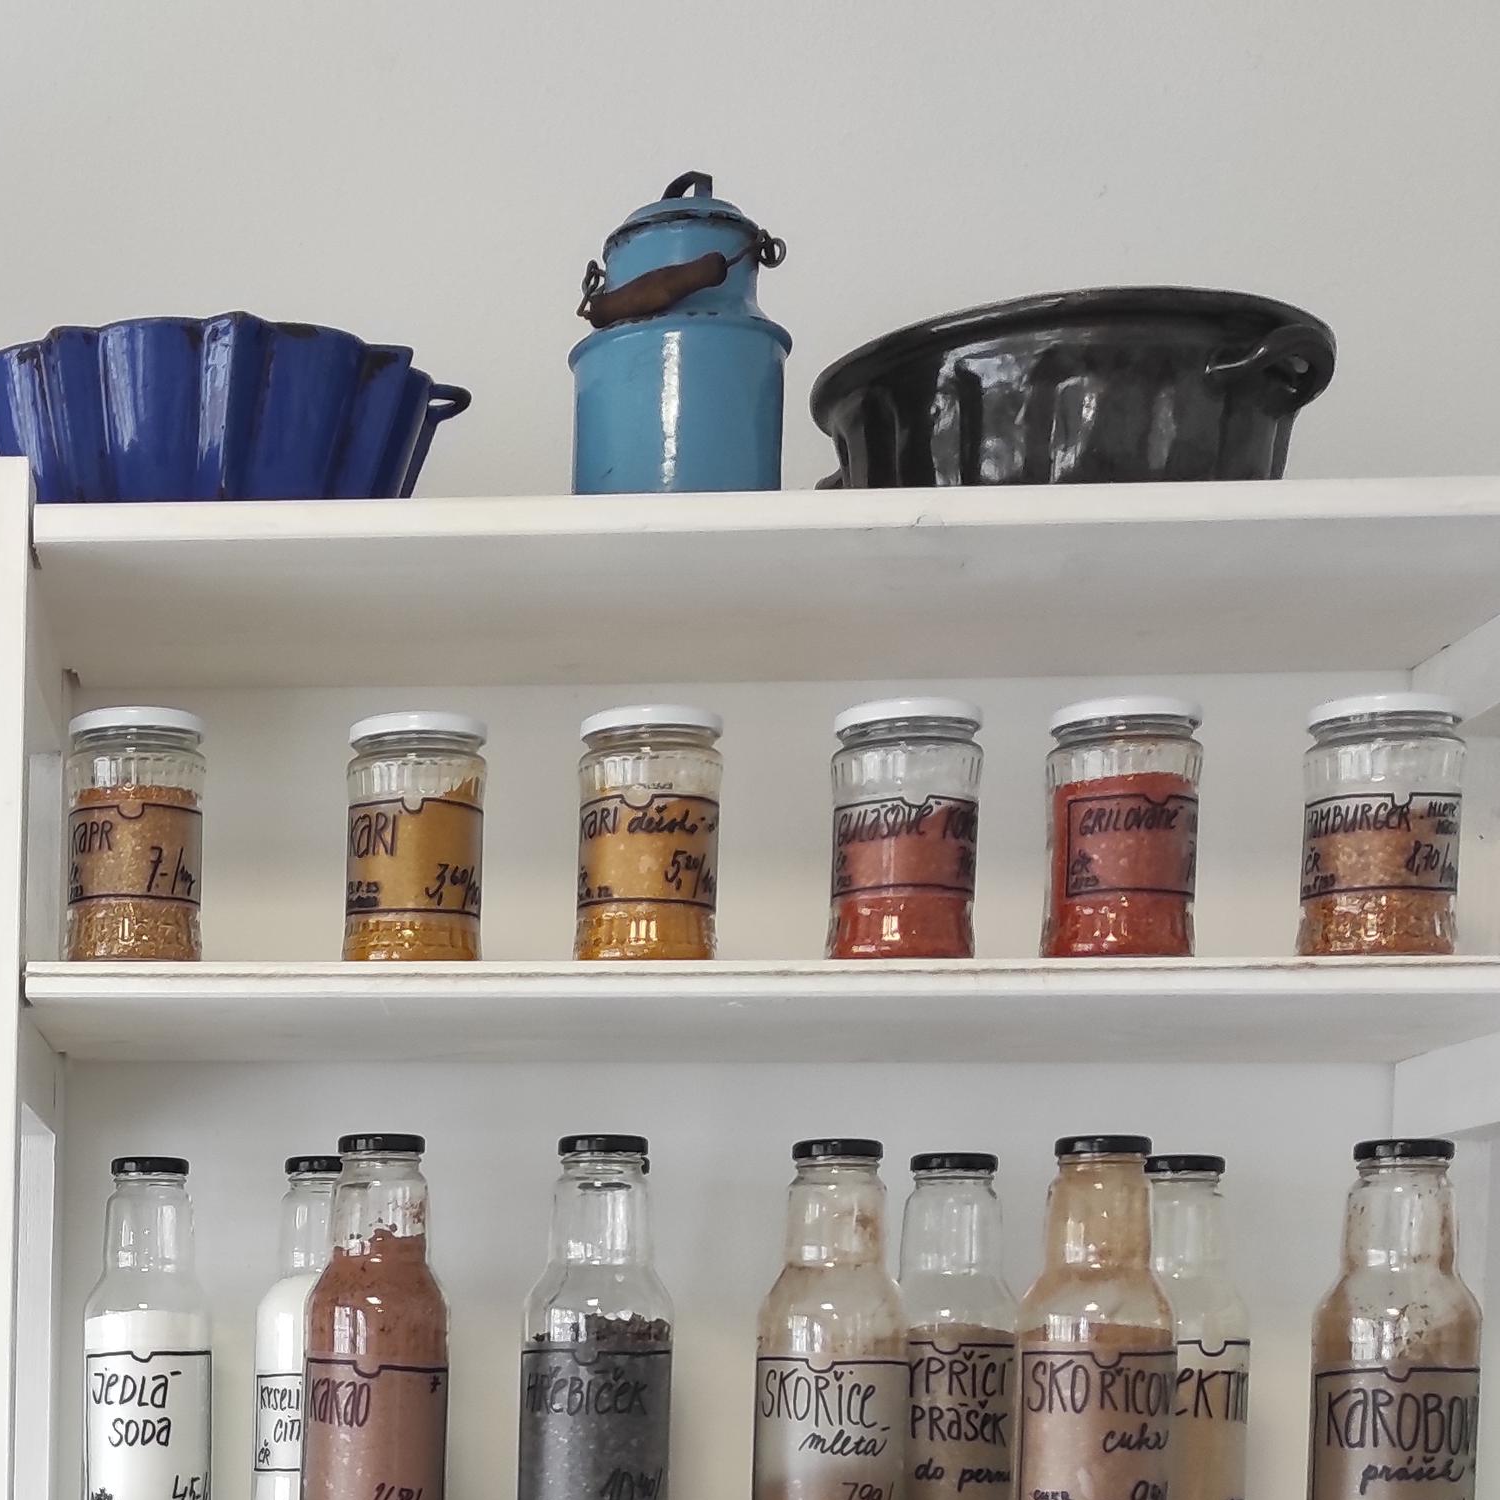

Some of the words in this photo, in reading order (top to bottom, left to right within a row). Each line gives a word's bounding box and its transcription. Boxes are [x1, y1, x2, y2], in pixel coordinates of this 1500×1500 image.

[71, 820, 113, 859] KAPR
[349, 810, 403, 858] KARI
[581, 806, 619, 840] KARI
[92, 1368, 182, 1409] JEDLÁ
[260, 1382, 301, 1411] KYSELI
[526, 1366, 647, 1416] HŘEBÍČEK
[907, 1350, 1013, 1399] YPŘÍCÍ
[1027, 1358, 1179, 1417] SKOŘICOV
[1175, 1366, 1248, 1424] EKTIN
[310, 1377, 372, 1428] KAKAO
[761, 1368, 877, 1429] SKOŘICE
[108, 1417, 172, 1448] SODA
[798, 1426, 891, 1457] mletá
[911, 1399, 1008, 1447] PRÁŠEK
[1102, 1422, 1169, 1454] cukr
[1326, 1387, 1477, 1456] KAROBOV
[258, 1438, 271, 1466] ČR
[915, 1457, 945, 1481] do
